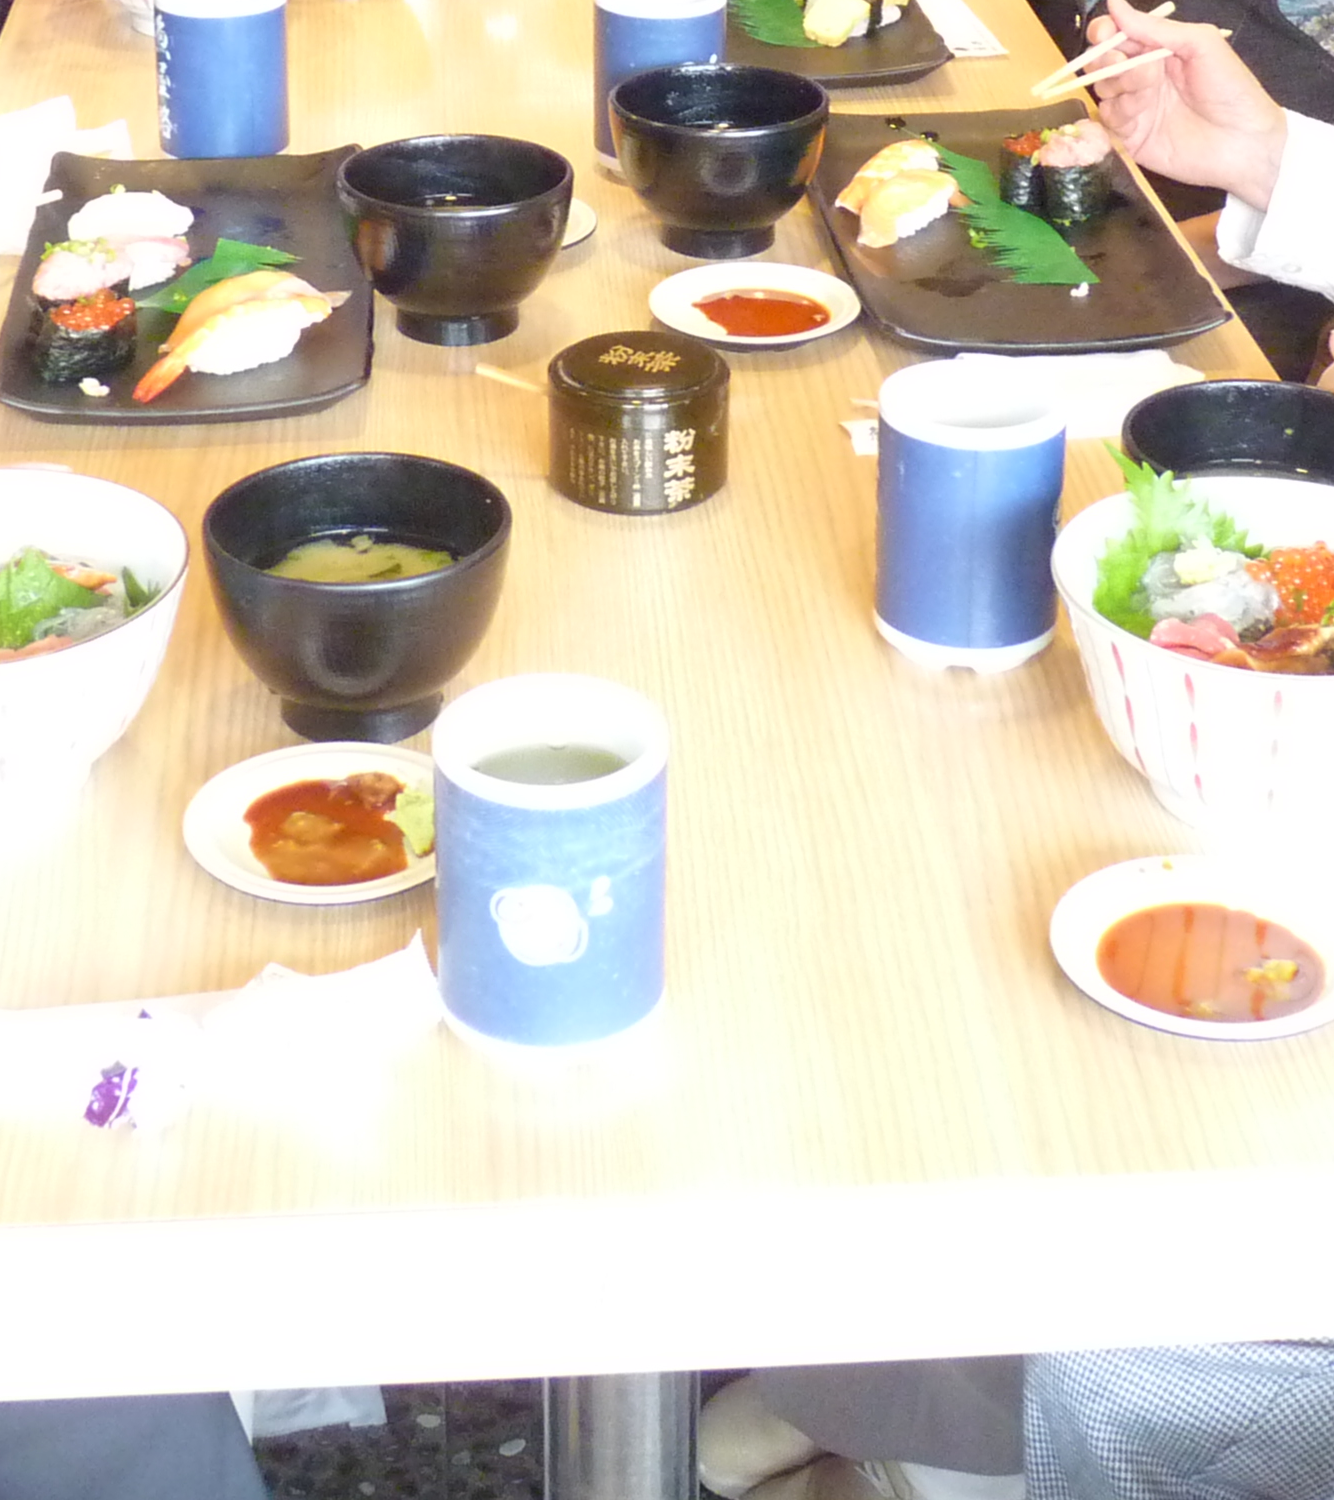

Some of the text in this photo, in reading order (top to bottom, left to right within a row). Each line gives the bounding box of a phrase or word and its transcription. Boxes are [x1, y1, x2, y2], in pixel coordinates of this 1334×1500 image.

[599, 344, 682, 373] 粉末茶
[663, 427, 697, 509] 粉末茶
